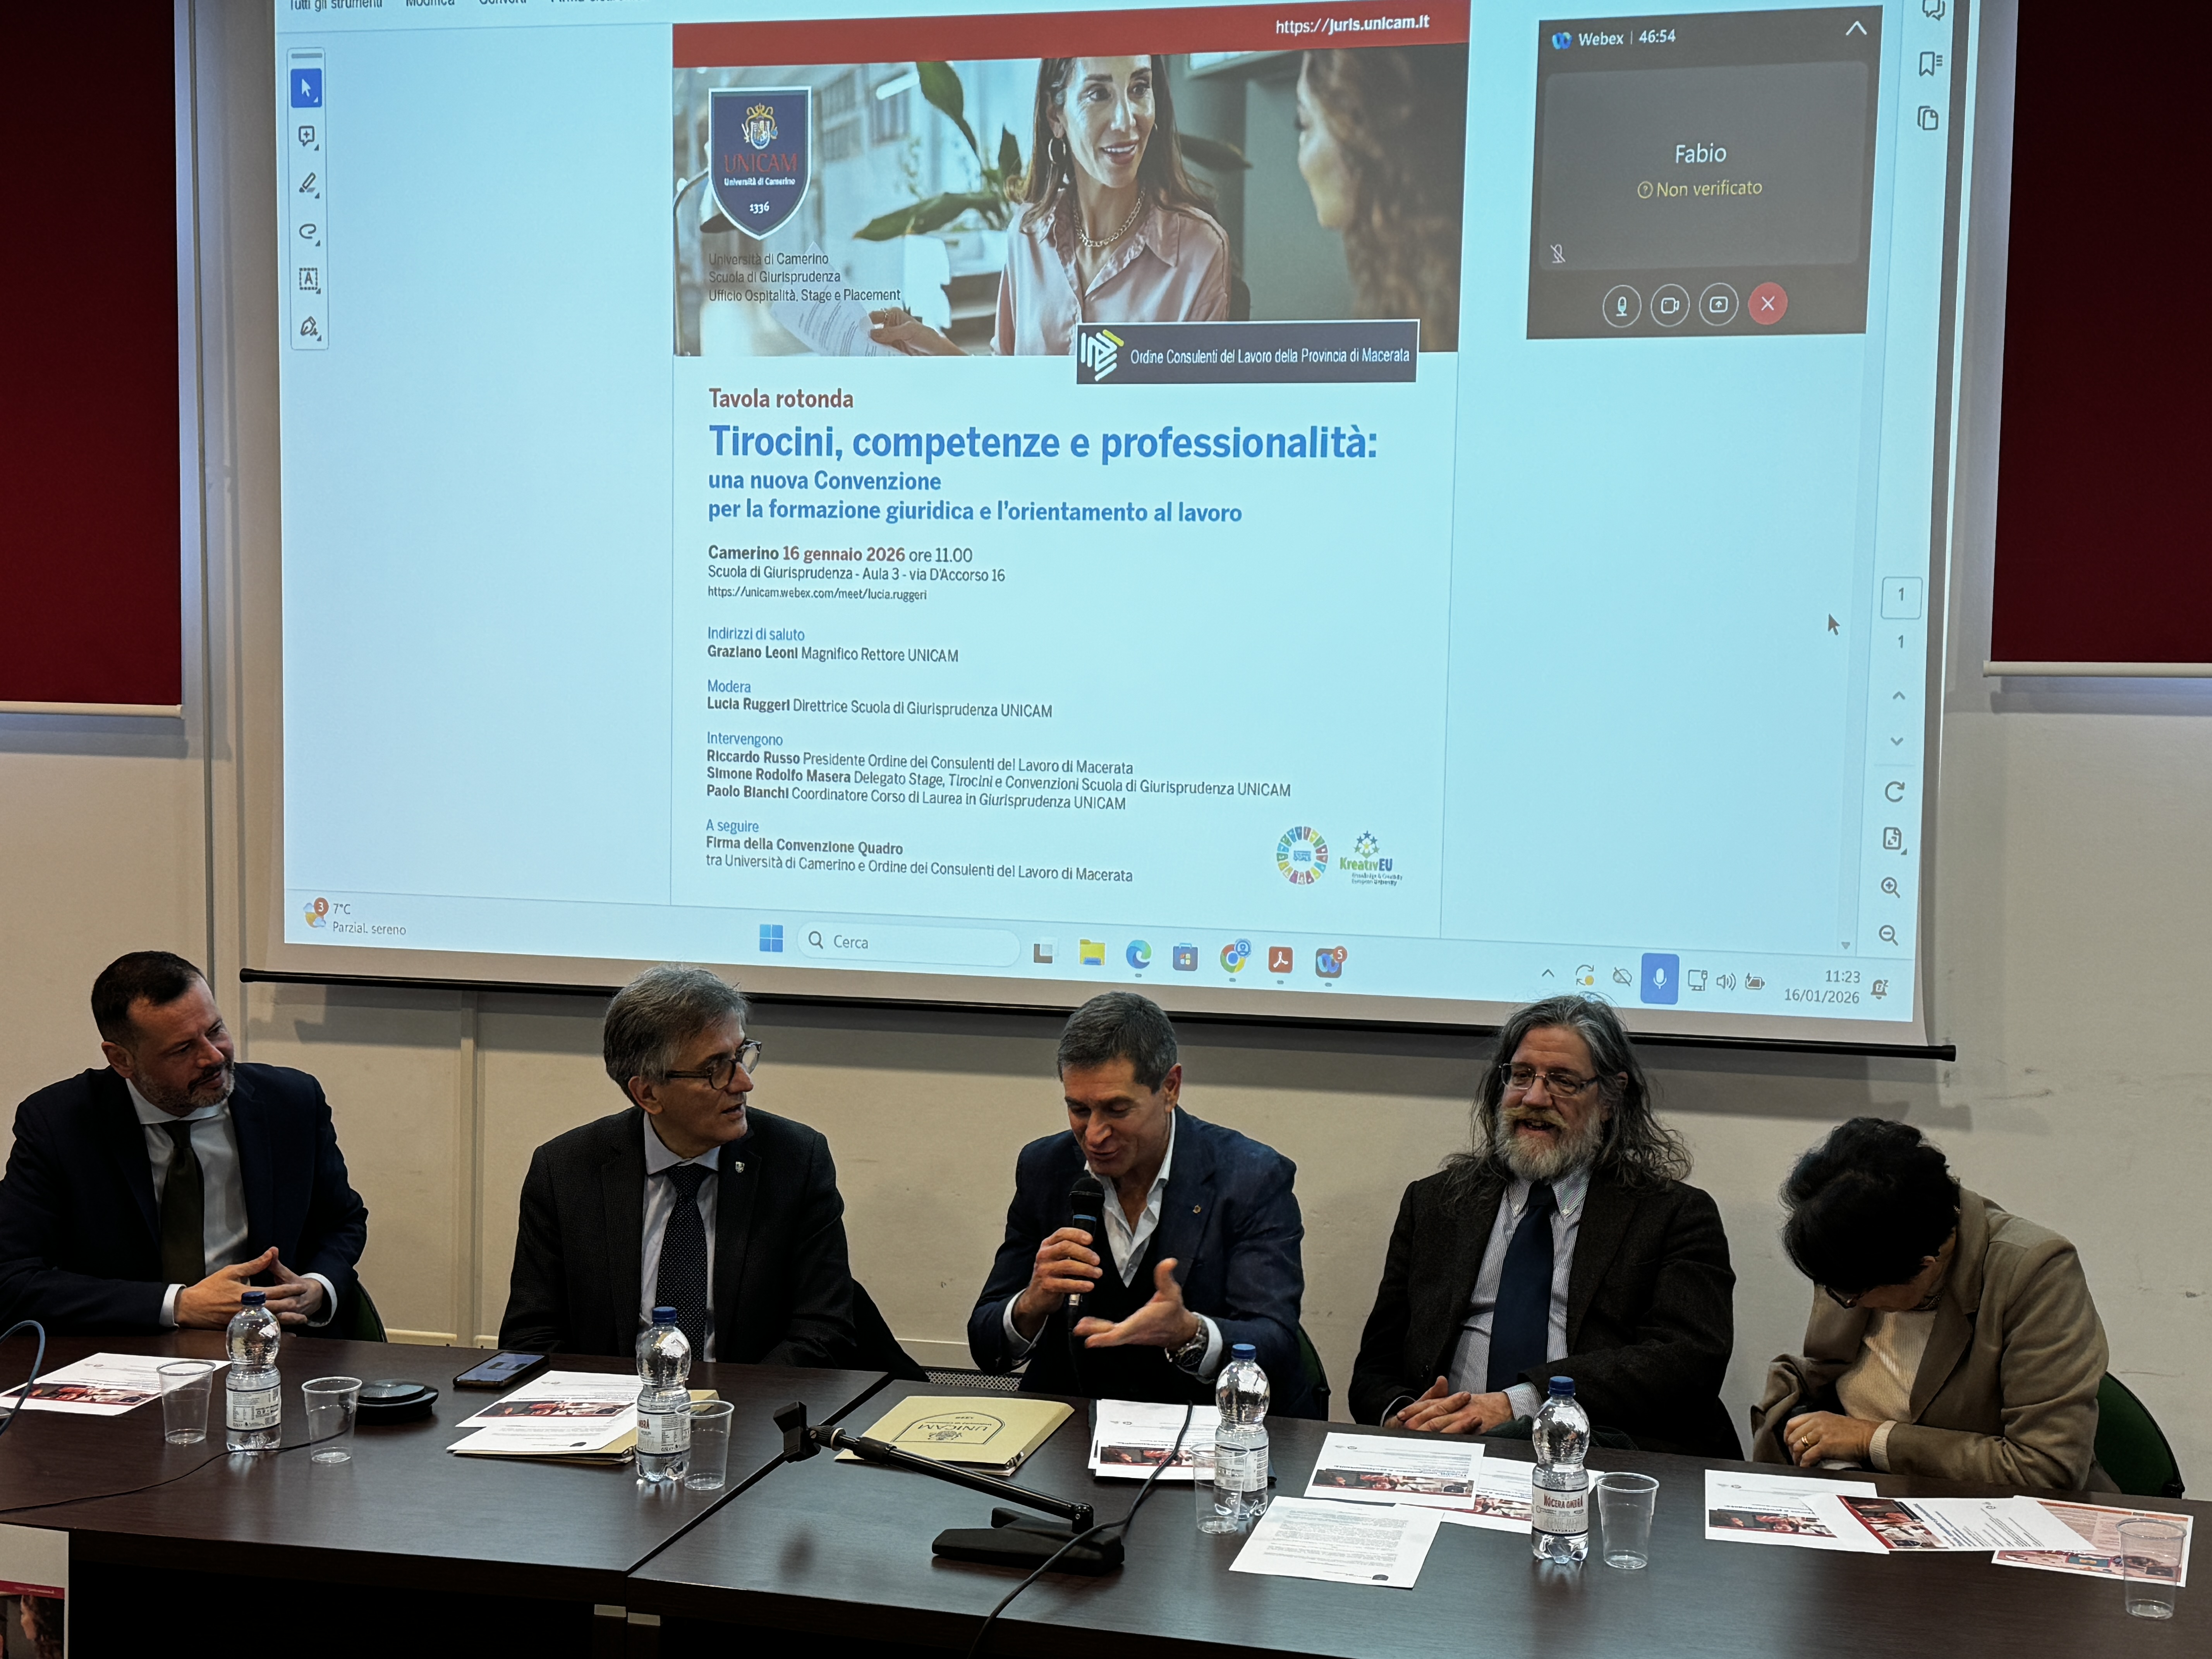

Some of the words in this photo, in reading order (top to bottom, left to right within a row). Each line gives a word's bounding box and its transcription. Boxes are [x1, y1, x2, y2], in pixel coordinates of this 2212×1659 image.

[1276, 15, 1430, 36] https://juris.unicam.it
[1579, 31, 1623, 46] Webex
[1639, 29, 1676, 43] 46:54
[1676, 143, 1726, 163] Fabio
[724, 153, 796, 172] UNICAM
[725, 177, 756, 185] Università
[1657, 182, 1687, 197] Non
[1693, 180, 1762, 196] verificato
[750, 201, 769, 213] 1336
[709, 252, 761, 265] Università
[764, 253, 773, 264] di
[777, 253, 828, 264] Camerino
[709, 271, 744, 283] Scuola
[747, 271, 757, 282] di
[760, 271, 840, 285] Giurisprudenza
[709, 289, 742, 301] Ufficio
[745, 289, 798, 303] Ospitalità,
[802, 289, 831, 303] Stage
[835, 292, 840, 301] e
[844, 289, 900, 301] Placement
[1131, 350, 1163, 364] Ordine
[1167, 349, 1218, 363] Consulenti
[1221, 349, 1235, 363] del
[1238, 349, 1271, 363] Lavoro
[1275, 349, 1297, 362] della
[1302, 349, 1346, 362] Provincia
[1350, 348, 1358, 362] di
[1362, 348, 1409, 362] Macerata
[709, 388, 769, 407] Tavola
[777, 388, 853, 408] rotonda
[709, 425, 842, 461] Tirocini,
[854, 427, 1060, 464] competenze
[1071, 434, 1089, 457] e
[1102, 424, 1376, 465] professionalità:
[709, 475, 744, 488] una
[751, 475, 808, 489] nuova
[815, 471, 941, 490] Convenzione
[709, 504, 740, 522] per
[747, 498, 763, 517] la
[769, 498, 880, 519] formazione
[886, 500, 973, 524] giuridica
[980, 507, 991, 520] e
[998, 500, 1147, 521] l’orientamento
[1154, 501, 1171, 521] al
[1179, 502, 1242, 522] lavoro
[709, 545, 779, 560] Camerino
[783, 546, 799, 560] 16
[804, 547, 862, 563] gennaio
[866, 547, 905, 562] 2026
[909, 551, 931, 562] ore
[936, 548, 972, 562] 11.00
[709, 565, 747, 577] Scuola
[750, 566, 760, 577] di
[764, 566, 852, 581] Giurisprudenza
[863, 567, 888, 580] Aula
[892, 568, 899, 580] 3
[910, 568, 926, 580] via
[992, 569, 1005, 581] 16
[708, 586, 926, 603] https://unicam.webex.com/meet/lucia.ruggeri
[1899, 587, 1904, 601] 1
[708, 627, 752, 640] Indirizzi
[756, 628, 766, 640] di
[769, 628, 805, 641] saluto
[1898, 635, 1903, 648] 1
[708, 645, 761, 658] Graziano
[766, 646, 797, 659] Leoni
[802, 647, 858, 662] Magnifico
[861, 647, 905, 661] Rettore
[908, 649, 958, 662] UNICAM
[708, 679, 750, 692] Modera
[708, 697, 739, 709] Lucia
[744, 697, 790, 713] Ruggeri
[794, 699, 847, 713] Direttrice
[852, 700, 890, 713] Scuola
[893, 701, 904, 714] di
[907, 702, 997, 717] Giurisprudenza
[1001, 704, 1052, 717] UNICAM
[708, 732, 783, 747] Intervengono
[708, 749, 759, 763] Riccardo
[764, 751, 800, 764] Russo
[804, 752, 865, 766] Presidente
[868, 754, 907, 767] Ordine
[910, 755, 927, 768] dei
[931, 756, 994, 770] Consulenti
[998, 758, 1015, 770] del
[1019, 758, 1059, 772] Lavoro
[1062, 760, 1072, 772] di
[1077, 760, 1133, 774] Macerata
[708, 766, 752, 780] Simone
[756, 768, 802, 781] Rodolfo
[807, 769, 850, 783] Masera
[855, 771, 905, 787] Delegato
[909, 773, 945, 788] Stage,
[949, 774, 993, 787] Tirocini
[995, 778, 1002, 788] e
[1006, 776, 1079, 790] Convenzioni
[1082, 778, 1122, 791] Scuola
[1126, 779, 1136, 792] di
[1140, 780, 1234, 795] Giurisprudenza
[1238, 783, 1290, 797] UNICAM
[707, 784, 740, 797] Paolo
[744, 785, 788, 799] Bianchi
[792, 787, 868, 801] Coordinatore
[871, 790, 905, 802] Corso
[908, 791, 919, 803] di
[923, 792, 962, 804] Laurea
[966, 793, 976, 805] in
[980, 793, 1070, 809] Giurisprudenza
[1075, 796, 1125, 809] UNICAM
[706, 819, 714, 831] A
[718, 820, 759, 835] seguire
[707, 836, 740, 848] Firma
[744, 837, 773, 850] della
[777, 838, 854, 853] Convenzione
[858, 842, 903, 857] Quadro
[706, 855, 721, 866] tra
[725, 854, 782, 868] Università
[785, 857, 795, 869] di
[799, 857, 855, 871] Camerino
[858, 862, 865, 871] e
[869, 860, 907, 873] Ordine
[910, 862, 927, 874] dei
[931, 862, 994, 876] Consulenti
[997, 865, 1015, 877] del
[1019, 866, 1058, 879] Lavoro
[1062, 867, 1072, 879] di
[1077, 867, 1132, 882] Macerata
[1340, 857, 1392, 871] KreativEU
[319, 902, 323, 912] 3
[333, 903, 350, 914] 7°C
[333, 921, 368, 933] Parzial.
[372, 926, 406, 935] sereno
[834, 935, 868, 949] Cerca
[1337, 950, 1343, 960] 5
[1826, 970, 1860, 983] 11:23
[1785, 989, 1859, 1004] 16/01/2026
[1544, 1494, 1565, 1508] NOCERA
